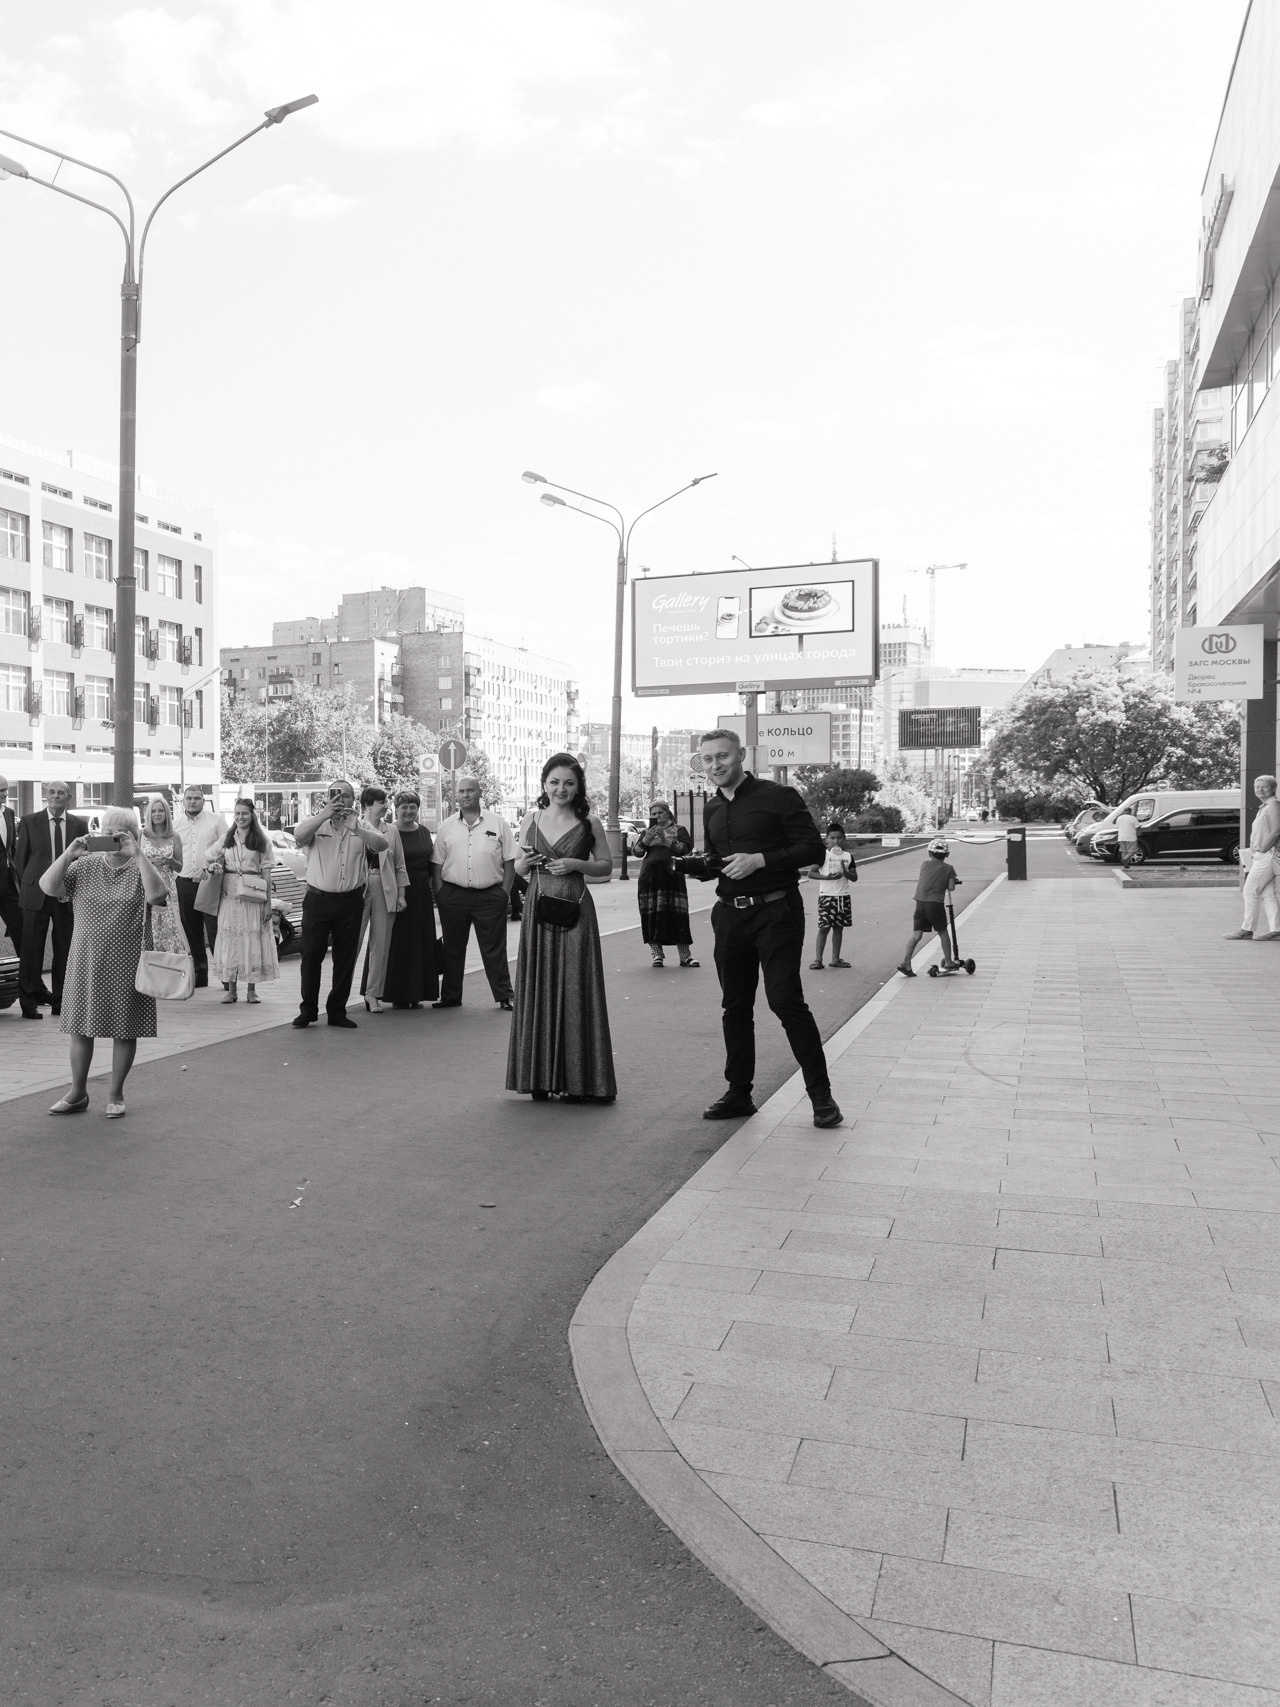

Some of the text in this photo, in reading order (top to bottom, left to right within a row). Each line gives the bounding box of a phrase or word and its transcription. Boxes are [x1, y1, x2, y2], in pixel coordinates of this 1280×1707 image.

[652, 592, 710, 612] Gallery
[652, 623, 701, 634] Печешь
[652, 631, 710, 645] тортики?
[652, 648, 856, 668] Твои сториз на улицах города
[1210, 658, 1251, 666] МОСКВЫ
[738, 681, 761, 691] Gallery
[767, 726, 813, 737] КОЛЬЦО
[768, 749, 784, 758] 00
